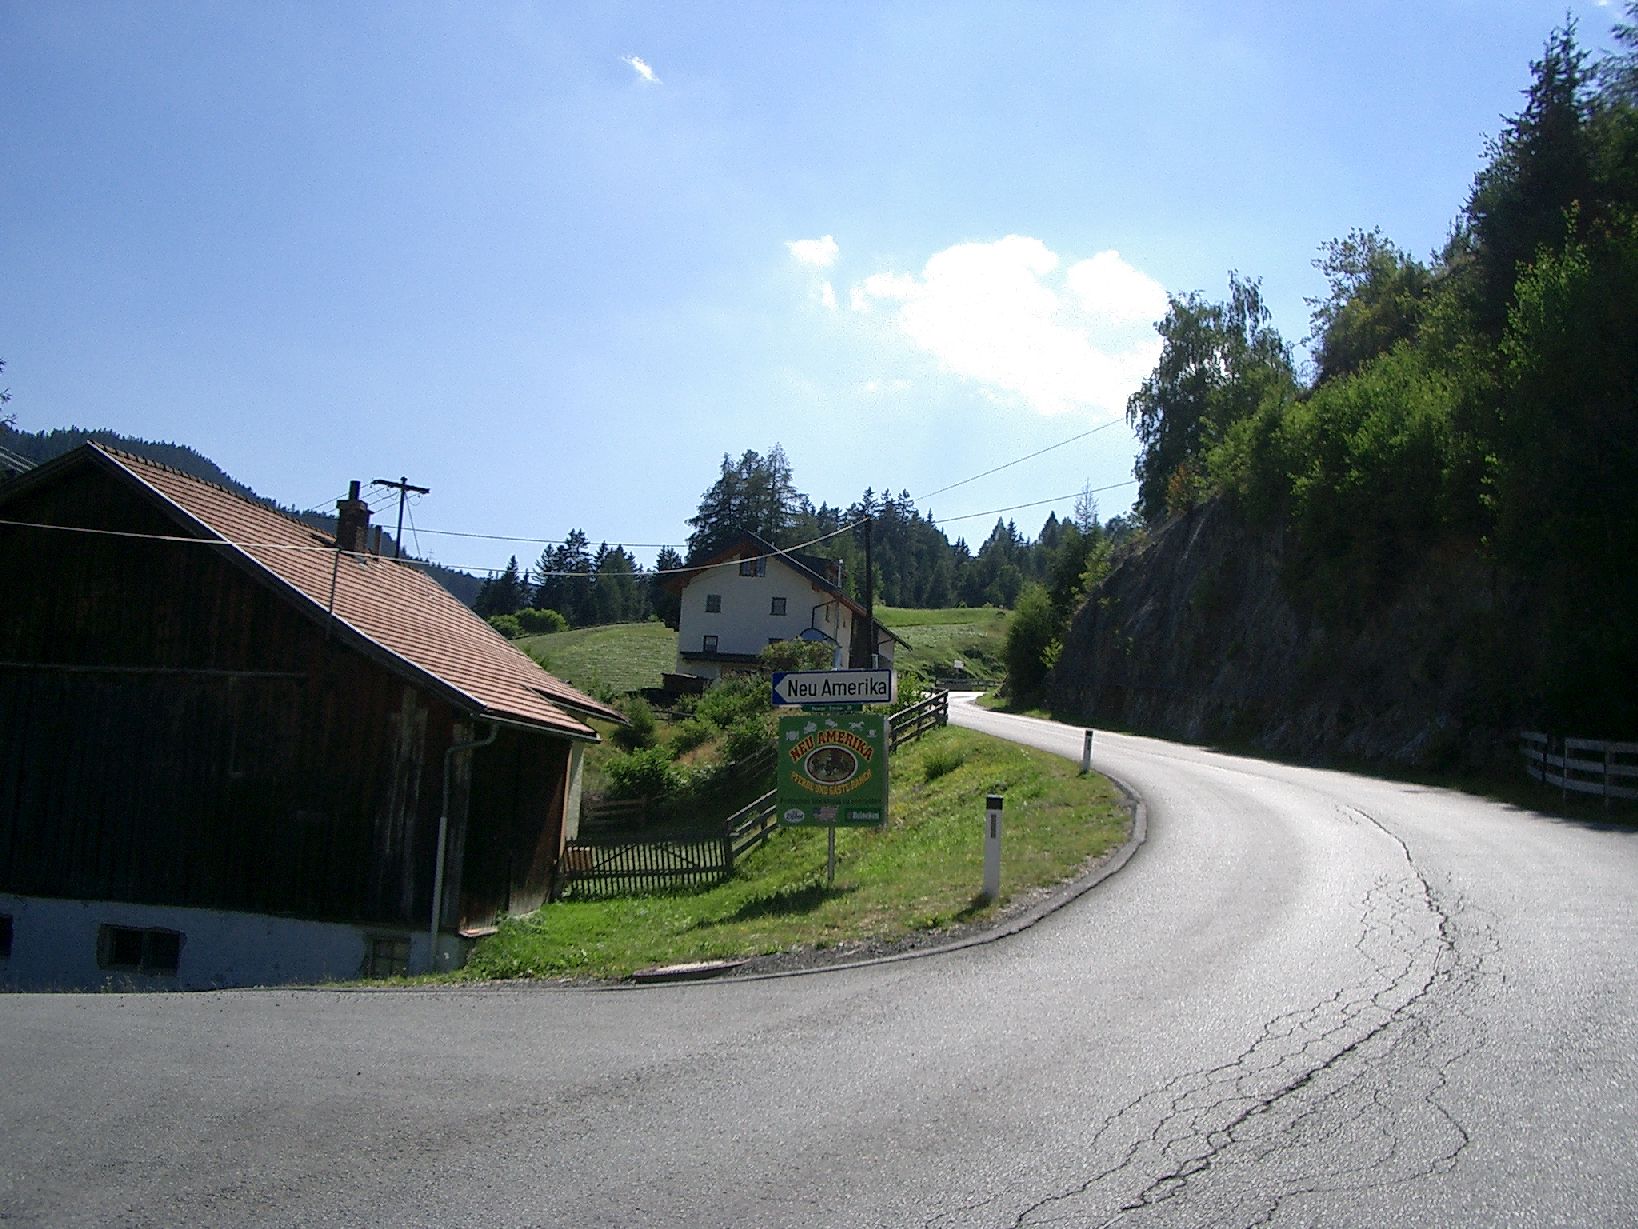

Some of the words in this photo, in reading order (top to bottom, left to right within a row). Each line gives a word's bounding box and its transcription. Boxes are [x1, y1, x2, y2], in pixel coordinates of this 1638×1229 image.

[788, 679, 816, 697] Neu
[821, 677, 887, 696] Amerika
[789, 735, 815, 762] NEU
[817, 729, 874, 762] AMERIKA
